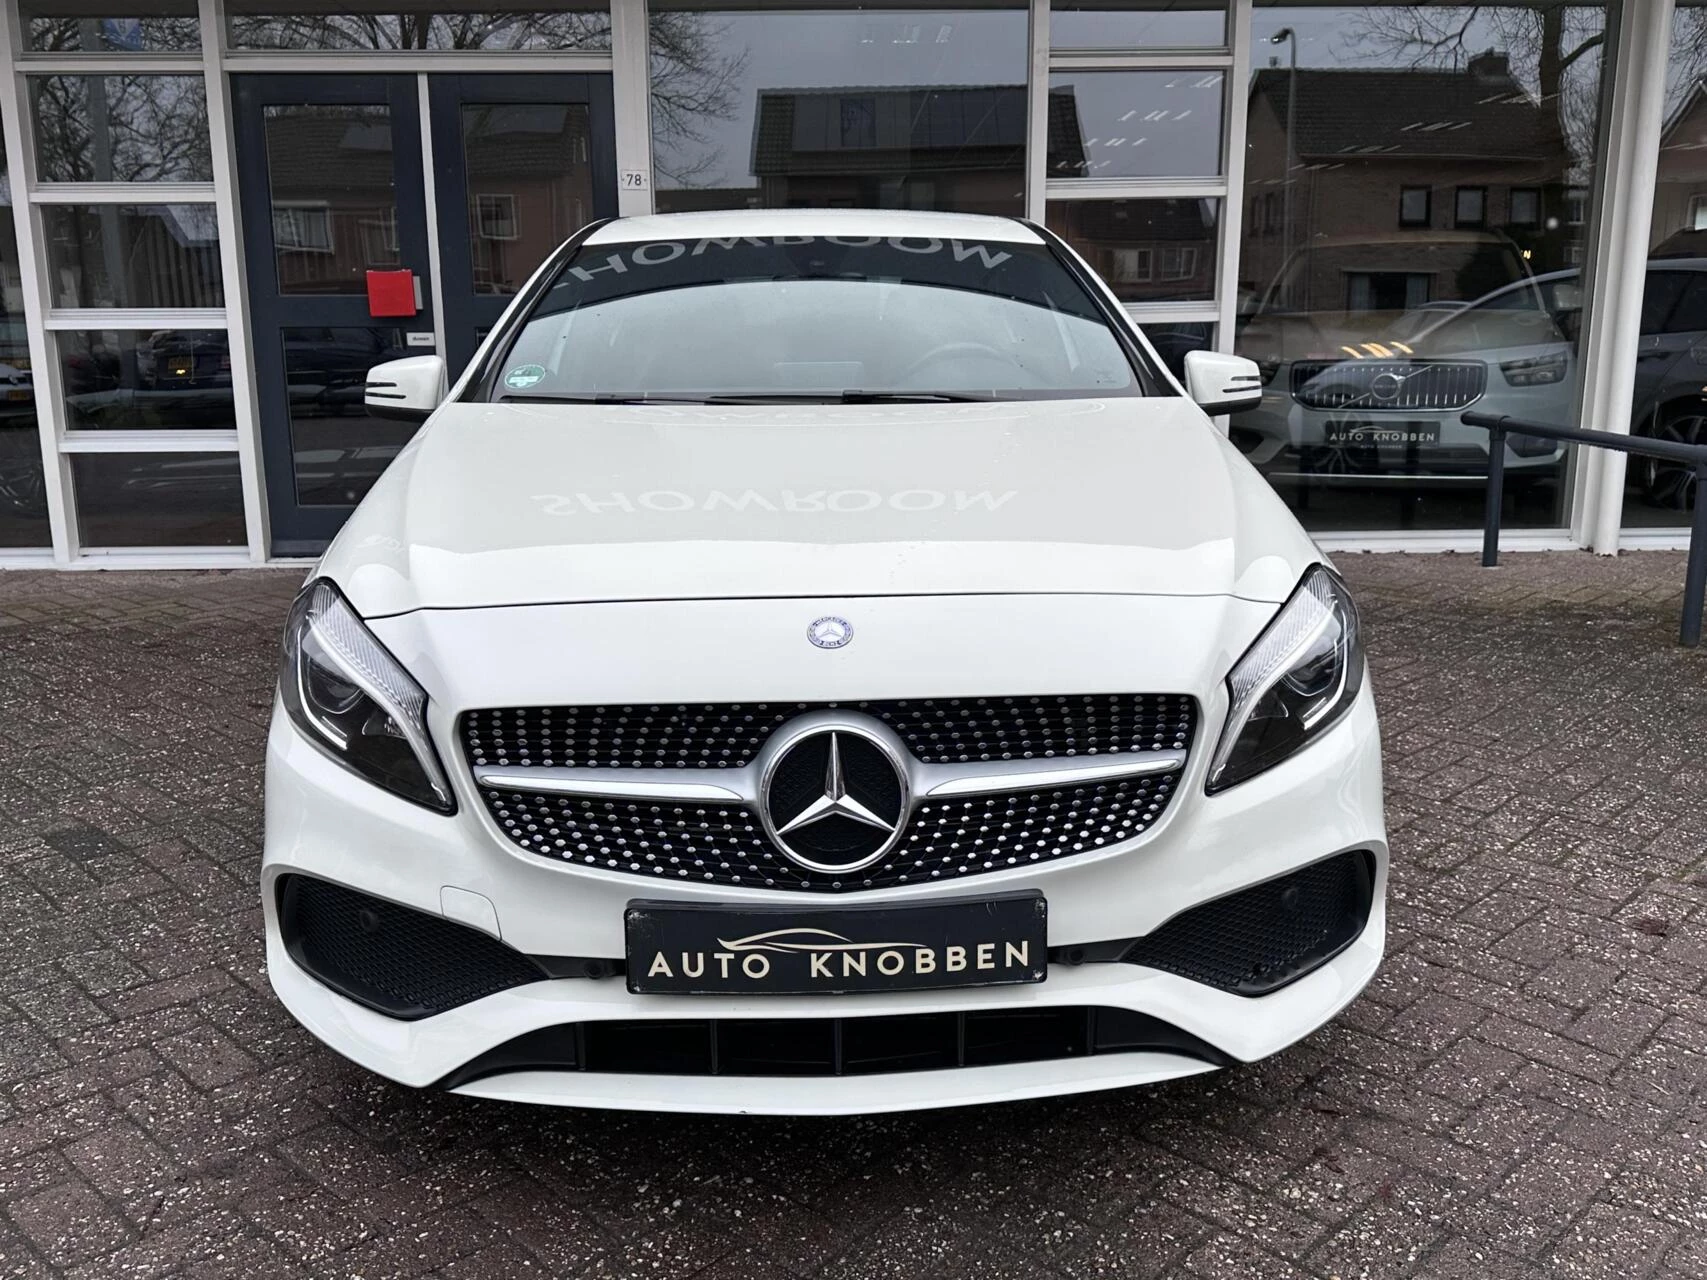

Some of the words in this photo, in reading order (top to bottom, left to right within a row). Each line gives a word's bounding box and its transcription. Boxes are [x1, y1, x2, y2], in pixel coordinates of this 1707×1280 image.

[626, 173, 641, 186] 78
[1330, 432, 1364, 441] AUTO
[1373, 432, 1435, 441] KNOBBEN
[647, 951, 770, 979] AUTO
[810, 940, 1029, 979] KNOBBEN
